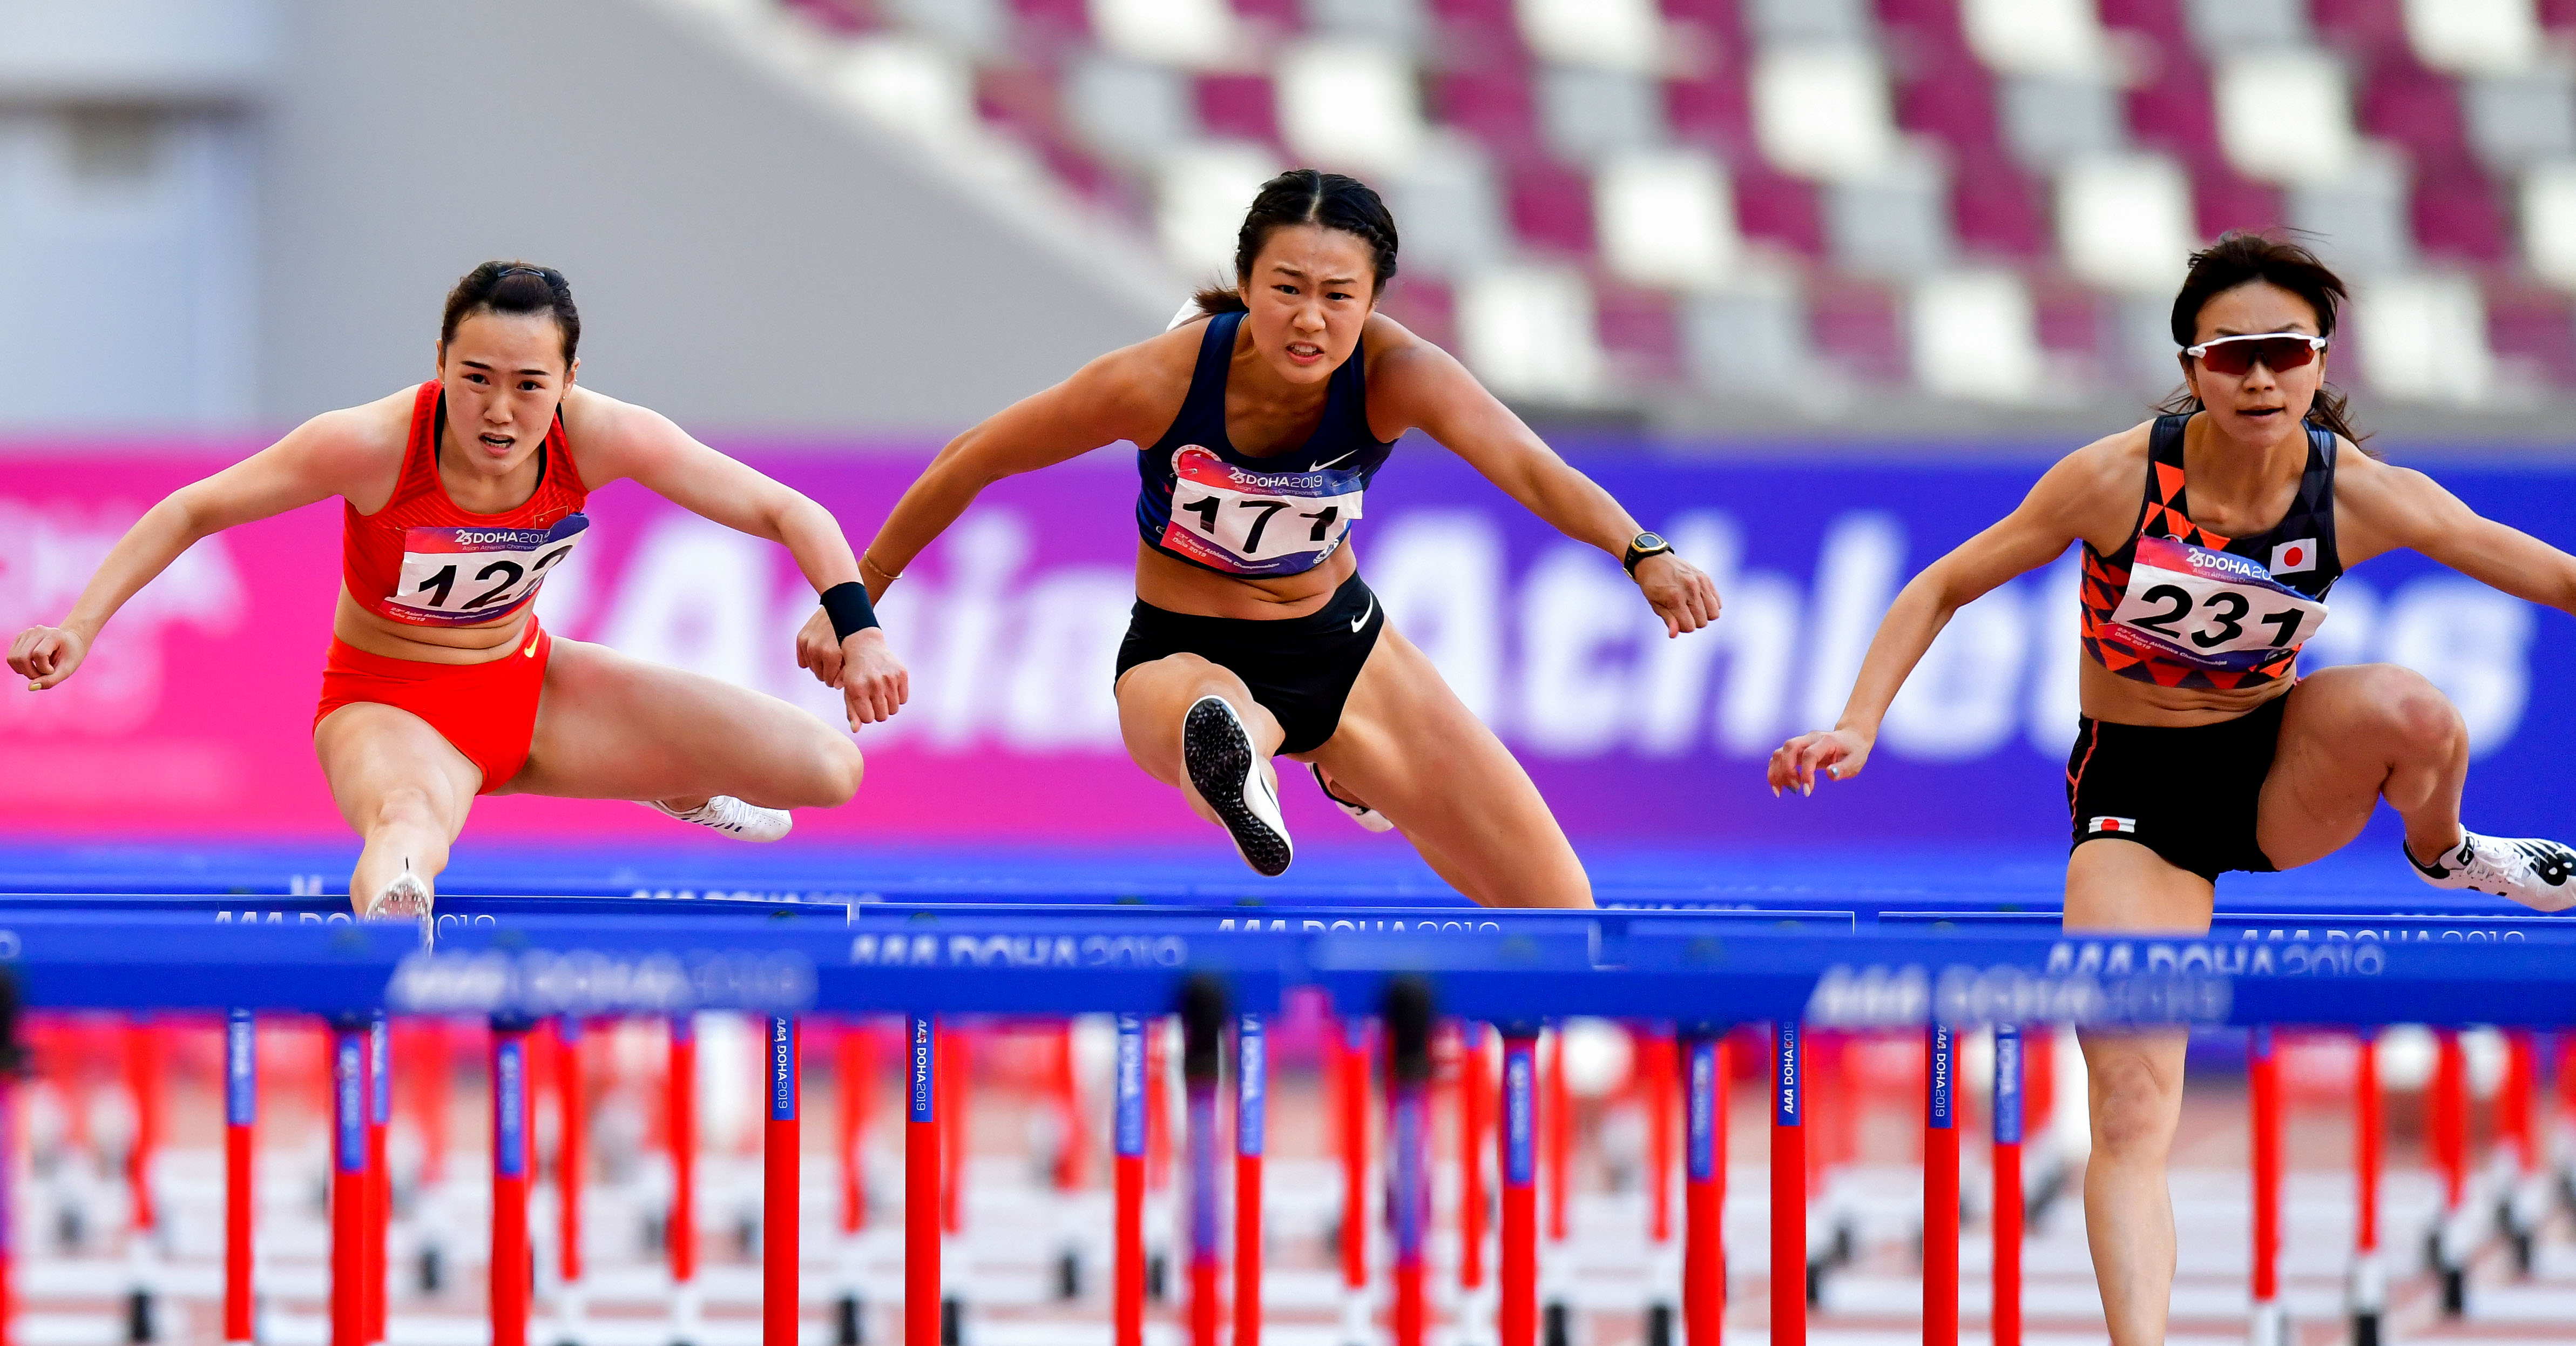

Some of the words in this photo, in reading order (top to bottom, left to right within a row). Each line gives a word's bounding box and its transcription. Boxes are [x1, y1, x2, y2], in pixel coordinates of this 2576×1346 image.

[1278, 488, 1323, 496] Championships
[1182, 495, 1338, 554] 171
[1188, 546, 1207, 557] 2019
[1205, 548, 1233, 563] Athletics
[2192, 568, 2210, 576] Asian
[2210, 571, 2237, 582] Athletics
[2127, 584, 2305, 649] 231
[2131, 633, 2148, 644] Asian
[2149, 641, 2179, 655] Athletics
[777, 1045, 788, 1109] DOHA2019
[916, 1048, 927, 1111] DOHA2019
[1936, 1054, 1946, 1117] DOHA2019
[1784, 1089, 1794, 1114] AAA
